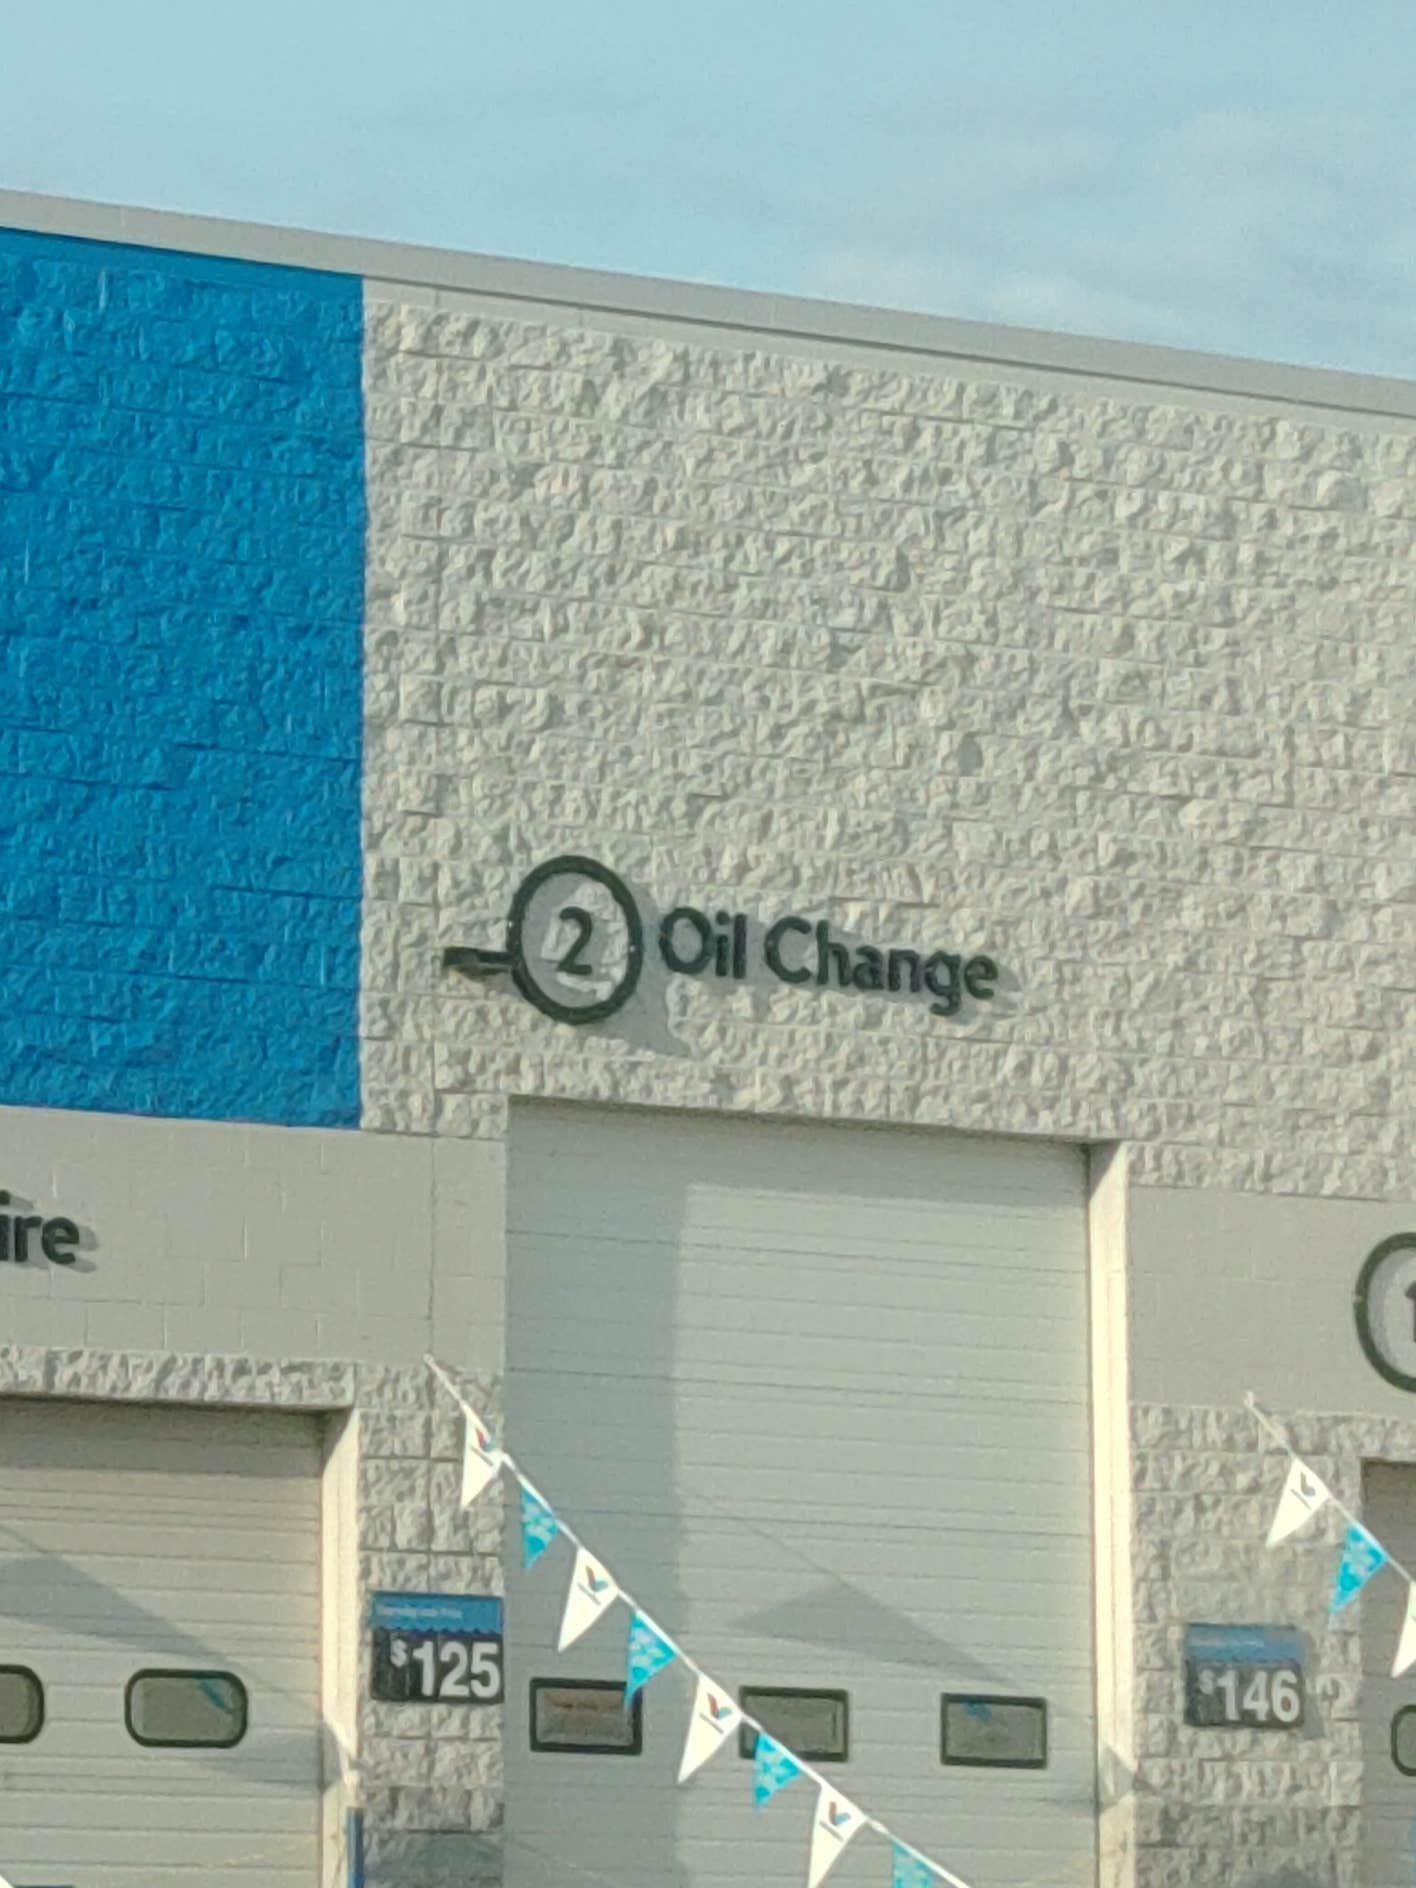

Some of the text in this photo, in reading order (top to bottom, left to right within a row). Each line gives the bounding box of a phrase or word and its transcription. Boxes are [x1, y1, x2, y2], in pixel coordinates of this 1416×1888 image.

[557, 907, 999, 1015] 2 Oil Change
[390, 1639, 500, 1699] $125
[1198, 1668, 1300, 1722] $146
